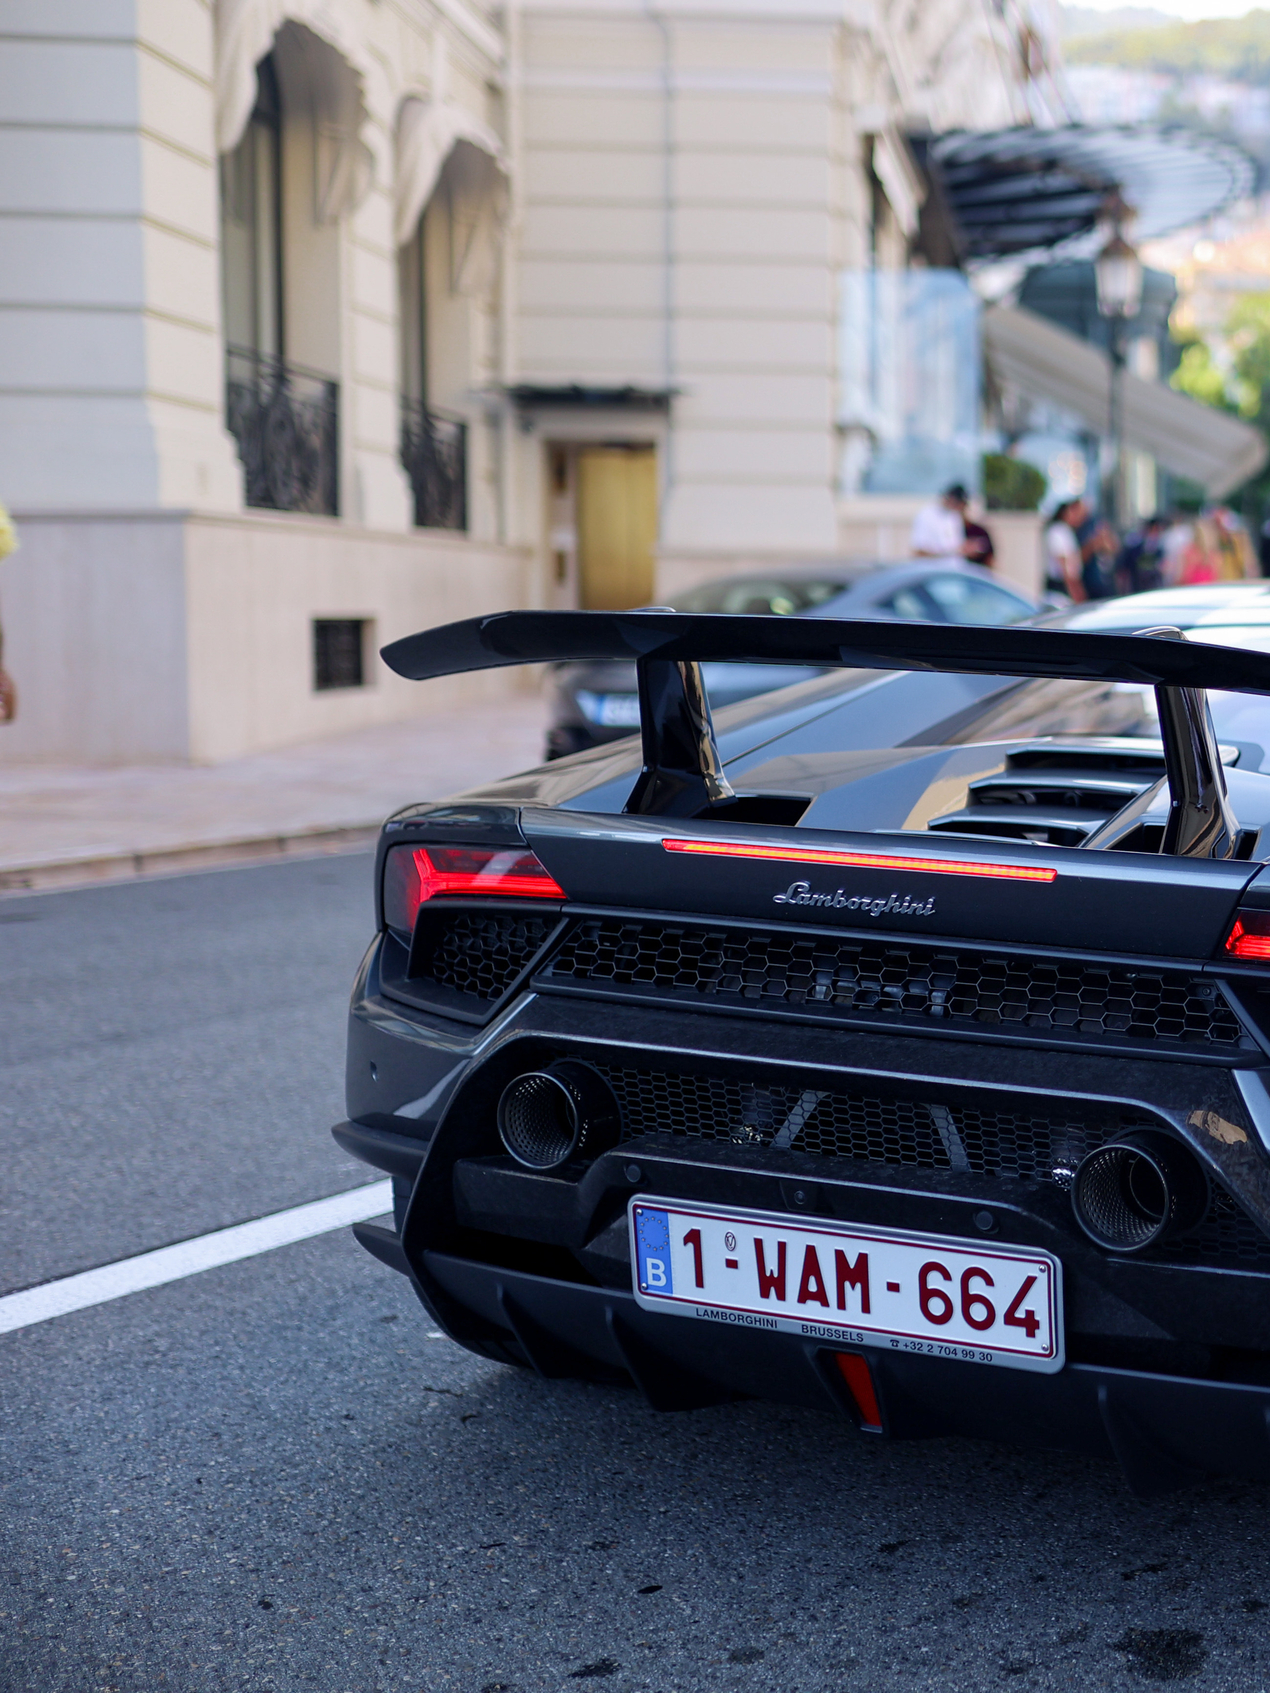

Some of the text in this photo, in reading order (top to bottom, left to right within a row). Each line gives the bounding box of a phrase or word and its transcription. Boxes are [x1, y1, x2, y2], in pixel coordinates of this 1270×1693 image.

[772, 880, 936, 917] Lamborghini
[646, 1258, 667, 1287] B
[696, 1308, 864, 1342] LAMBORGHINI BRUSSELS
[903, 1341, 993, 1362] +32 2 704 99 30
